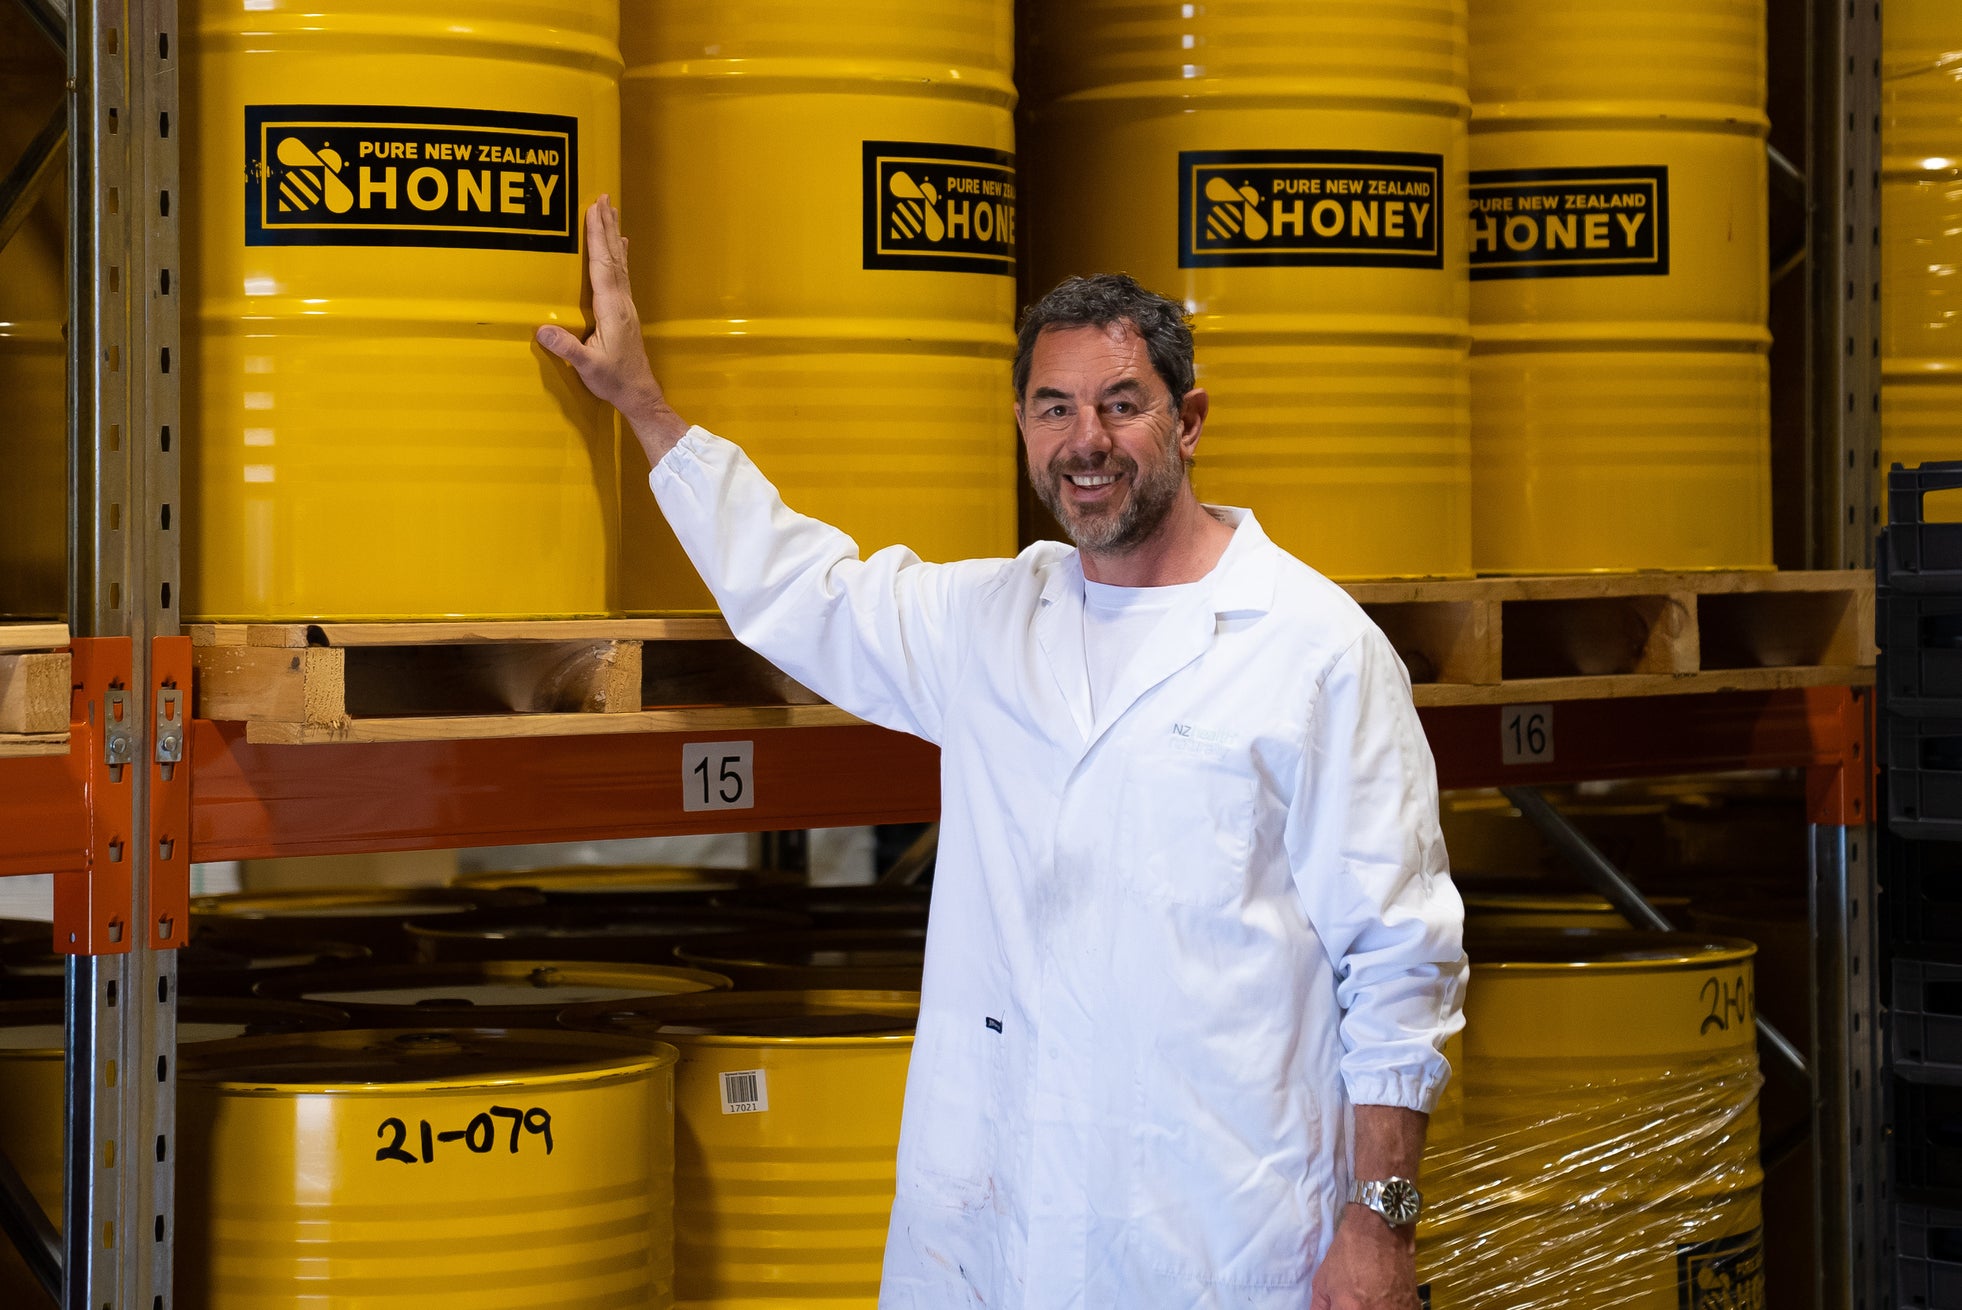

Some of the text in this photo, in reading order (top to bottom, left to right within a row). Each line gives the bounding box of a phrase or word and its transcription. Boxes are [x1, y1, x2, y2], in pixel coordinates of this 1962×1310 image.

[359, 141, 560, 166] PURE NEW ZEALAND
[359, 166, 560, 216] HONEY
[947, 177, 980, 194] PURE
[982, 180, 1002, 196] NEW
[1273, 179, 1431, 197] PURE NEW ZEALAND
[1469, 193, 1646, 212] PURE NEW ZEALAND
[1272, 199, 1431, 238] HONEY
[1469, 212, 1646, 252] HONEY
[1509, 713, 1546, 755] 16
[694, 756, 743, 804] 15
[730, 1103, 757, 1112] 17021
[376, 1105, 554, 1164] 21-079
